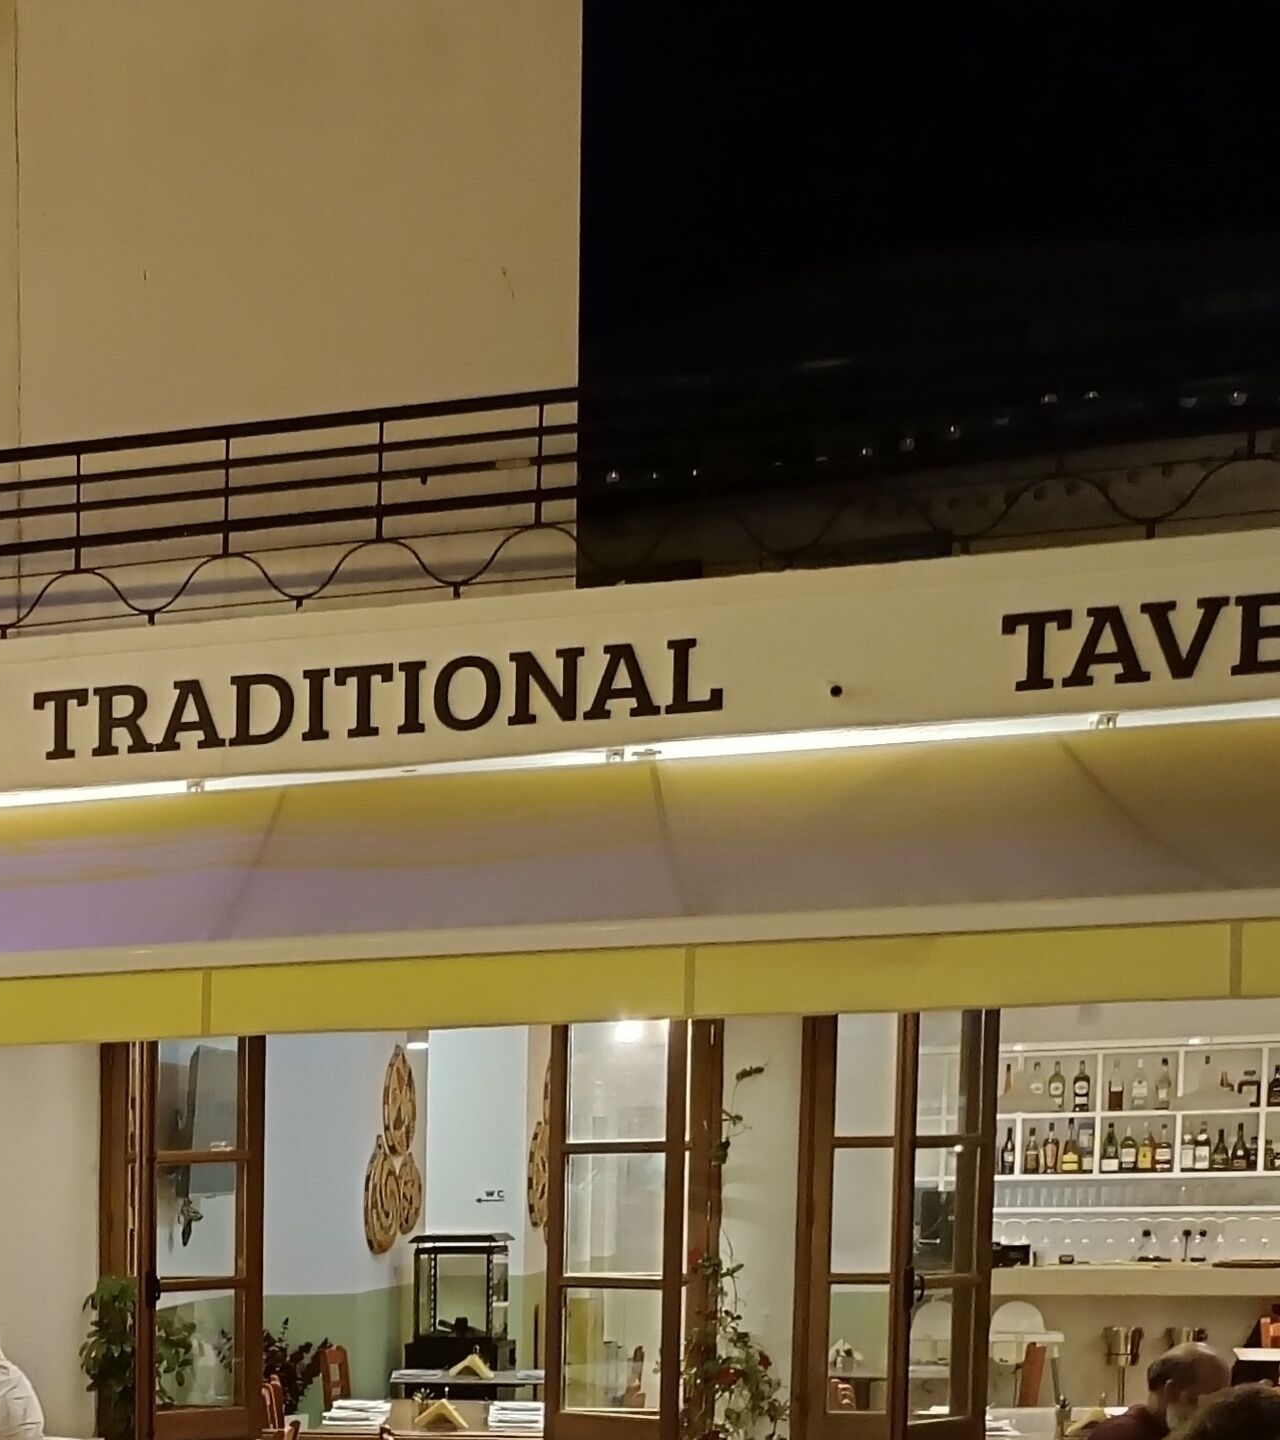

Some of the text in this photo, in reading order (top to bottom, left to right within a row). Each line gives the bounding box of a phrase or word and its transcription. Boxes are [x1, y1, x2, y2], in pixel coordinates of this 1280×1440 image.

[32, 591, 1280, 761] TRADITIONAL TAVE
[485, 1189, 505, 1199] WC
